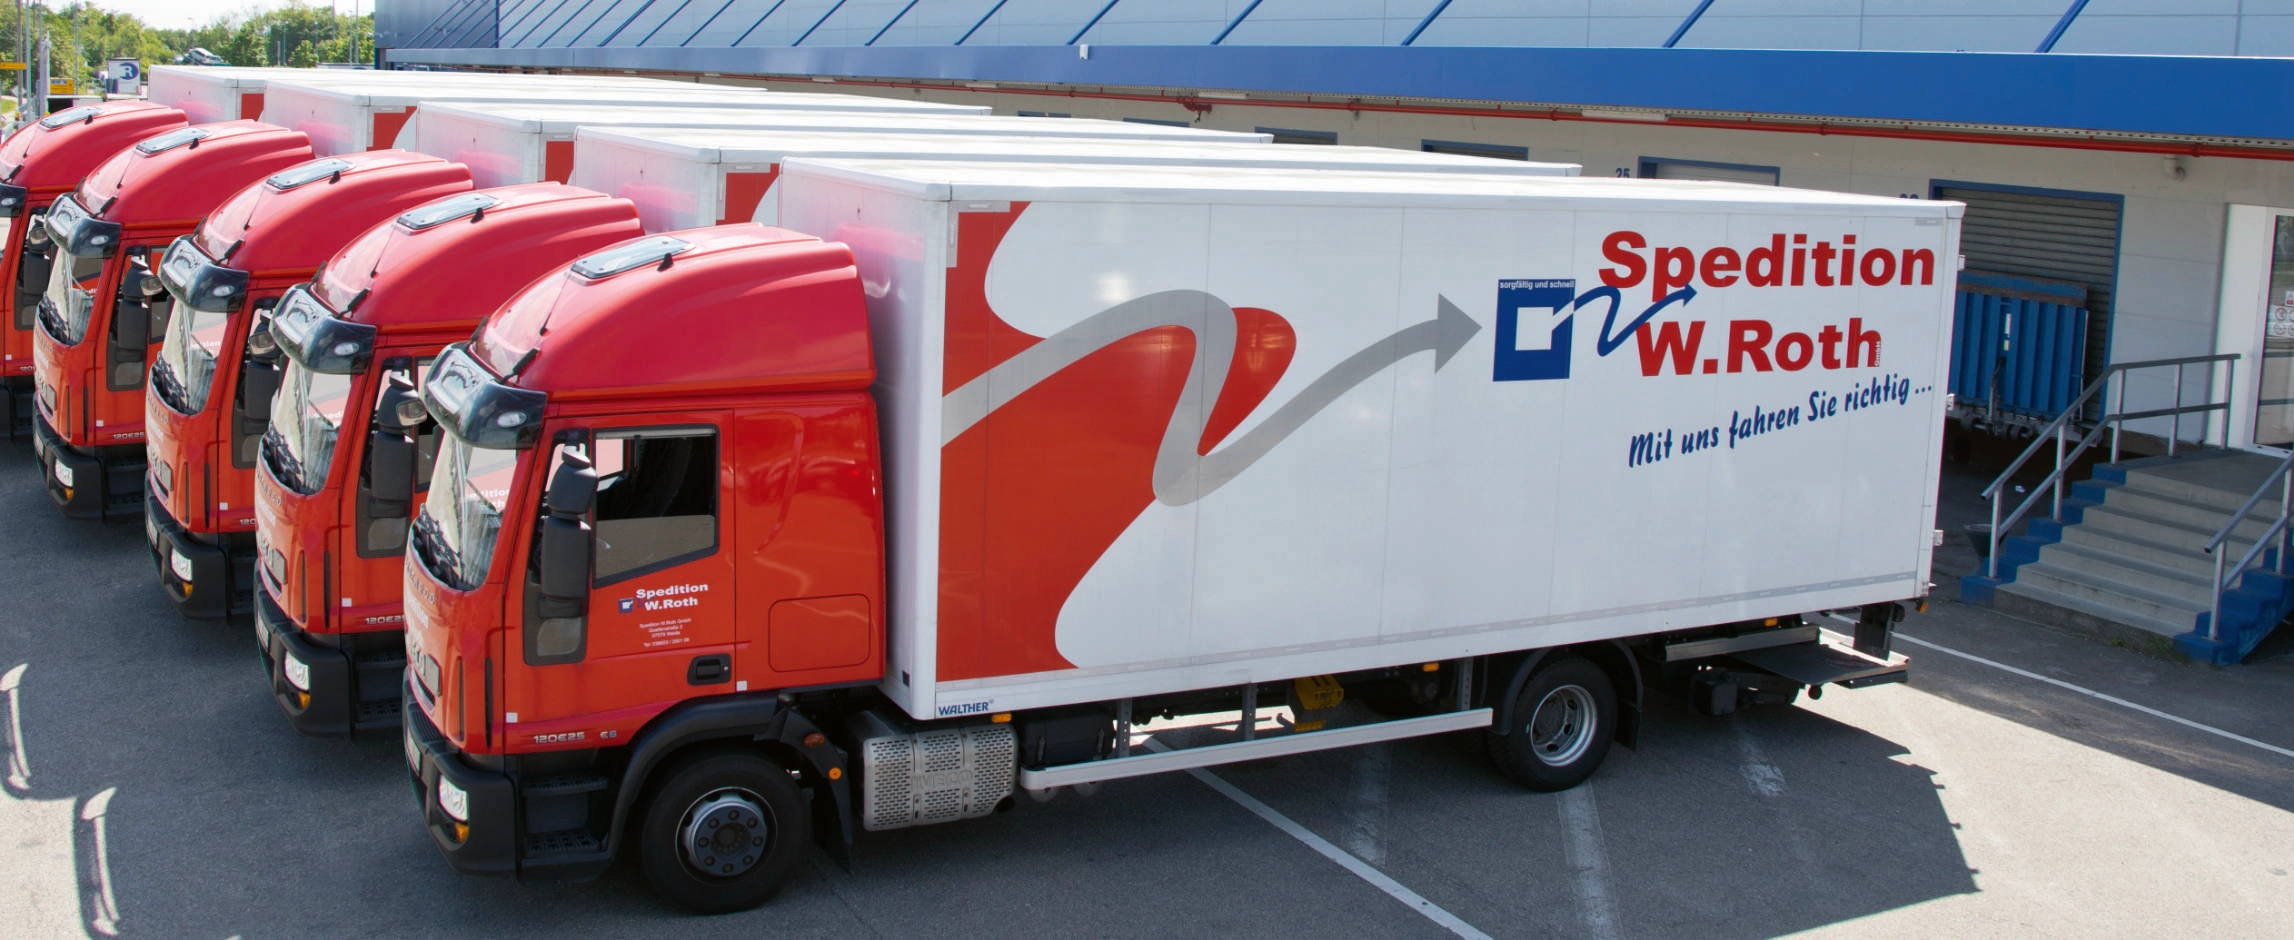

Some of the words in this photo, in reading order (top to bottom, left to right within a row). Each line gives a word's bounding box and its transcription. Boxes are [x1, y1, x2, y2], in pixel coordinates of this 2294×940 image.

[1598, 231, 1935, 303] Spedition
[1500, 280, 1534, 291] sorgfältig
[1534, 280, 1549, 289] und
[1549, 280, 1575, 289] schnell
[1635, 317, 1882, 377] W.Roth
[1628, 428, 1673, 469] Mit
[1681, 426, 1720, 455] uns
[1728, 405, 1800, 450] fahren
[1808, 390, 1838, 422] Sie
[1844, 373, 1911, 406] richtig
[635, 583, 709, 600] Spedition
[643, 596, 699, 612] W.Roth
[938, 701, 990, 716] WALTHER
[533, 731, 585, 744] 120E25
